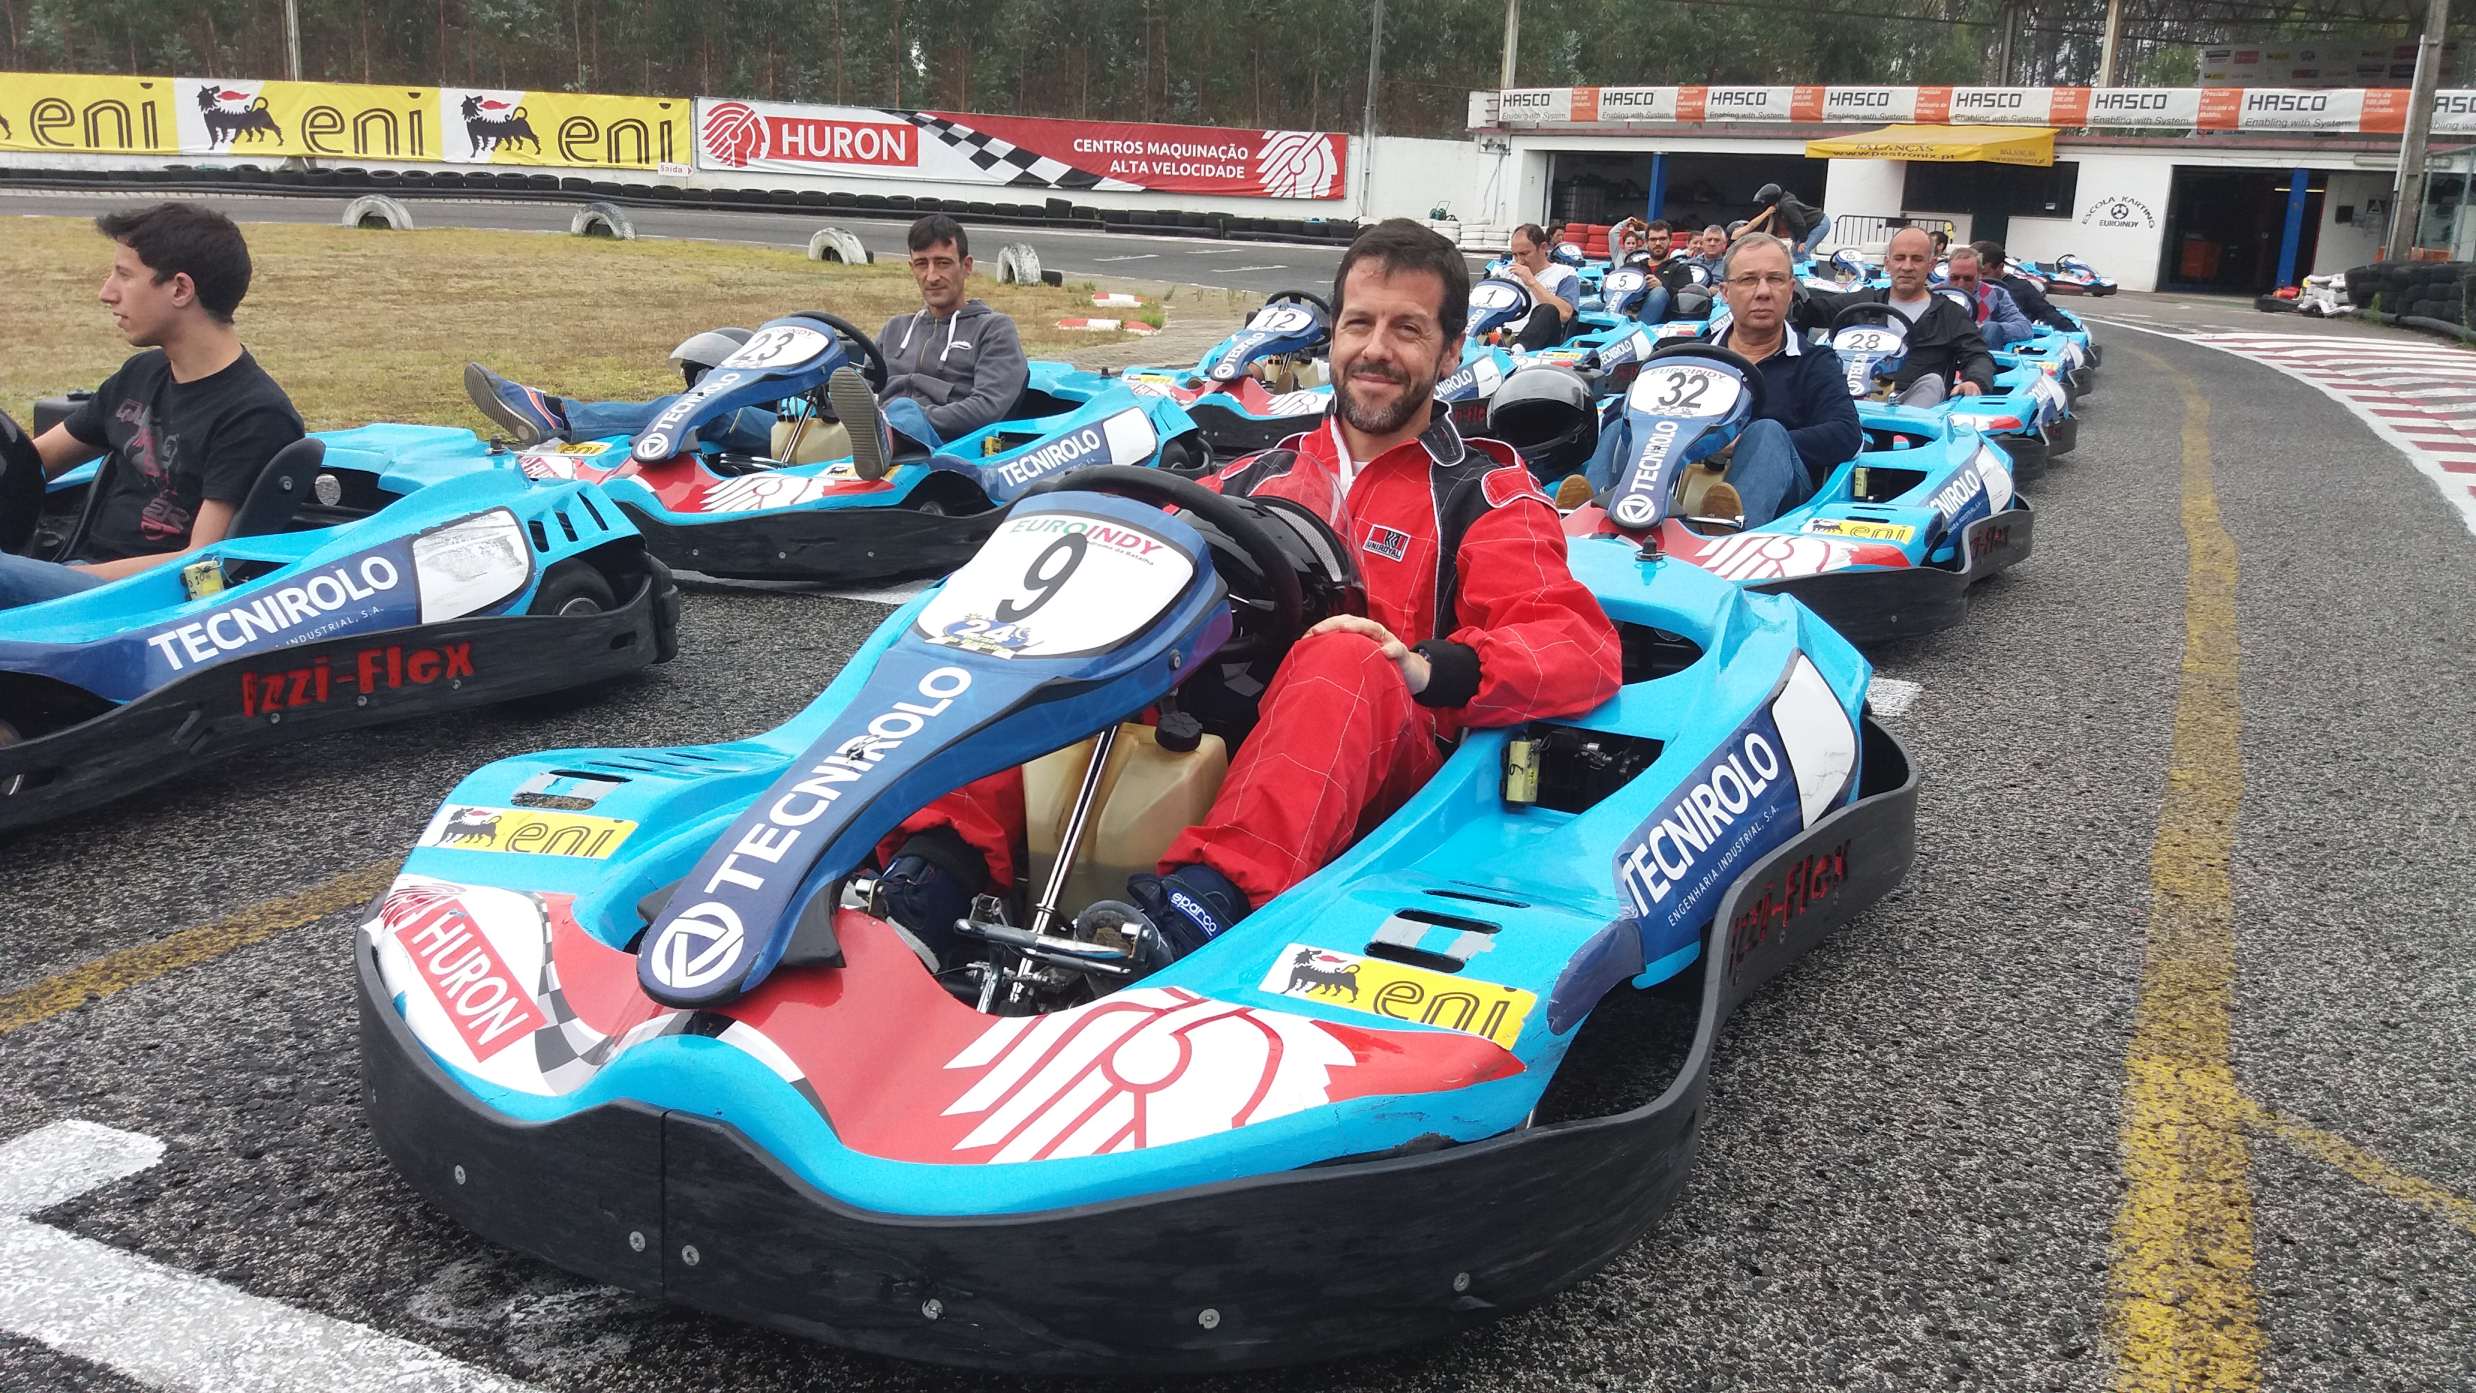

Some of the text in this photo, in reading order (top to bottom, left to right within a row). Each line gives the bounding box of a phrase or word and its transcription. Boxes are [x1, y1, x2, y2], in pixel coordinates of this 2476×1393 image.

[1503, 93, 1550, 107] HASCO
[1603, 92, 1654, 106] HASCO
[1711, 92, 1767, 106] HASCO
[1829, 92, 1890, 106] HASCO
[1956, 93, 2022, 107] HASCO
[2095, 94, 2167, 109] HASCO
[2248, 95, 2327, 111] HASCO
[30, 82, 159, 150] eni
[301, 92, 422, 156] eni
[558, 102, 672, 164] eni
[781, 123, 906, 161] HURON
[1073, 138, 1249, 162] CENTROS MAQUINAÇÃO
[1110, 160, 1246, 179] ALTA VELOCIDADE
[1485, 289, 1497, 305] 1
[1618, 274, 1628, 288] 5
[1264, 312, 1297, 329] 12
[733, 332, 794, 361] 23
[1847, 333, 1881, 349] 28
[1434, 369, 1473, 397] NIROLO
[1658, 371, 1710, 409] 32
[998, 428, 1101, 487] TECNIROLO
[1930, 469, 1981, 519] NIROLO
[1009, 519, 1164, 556] EUROINDY
[1366, 540, 1402, 559] UNIROYAL
[1850, 526, 1906, 540] eni
[994, 532, 1089, 624] 9
[147, 556, 399, 671] TECNIROLO
[704, 666, 972, 894] TECNIROLO
[505, 819, 624, 857] eni
[1621, 731, 1780, 918] TECNIROLO
[1668, 868, 1719, 927] ENGENHARIA
[1718, 822, 1765, 872] INDUSTRIAL,
[1171, 892, 1217, 936] sparco
[411, 911, 530, 1047] HURON
[1373, 978, 1519, 1040] eni
